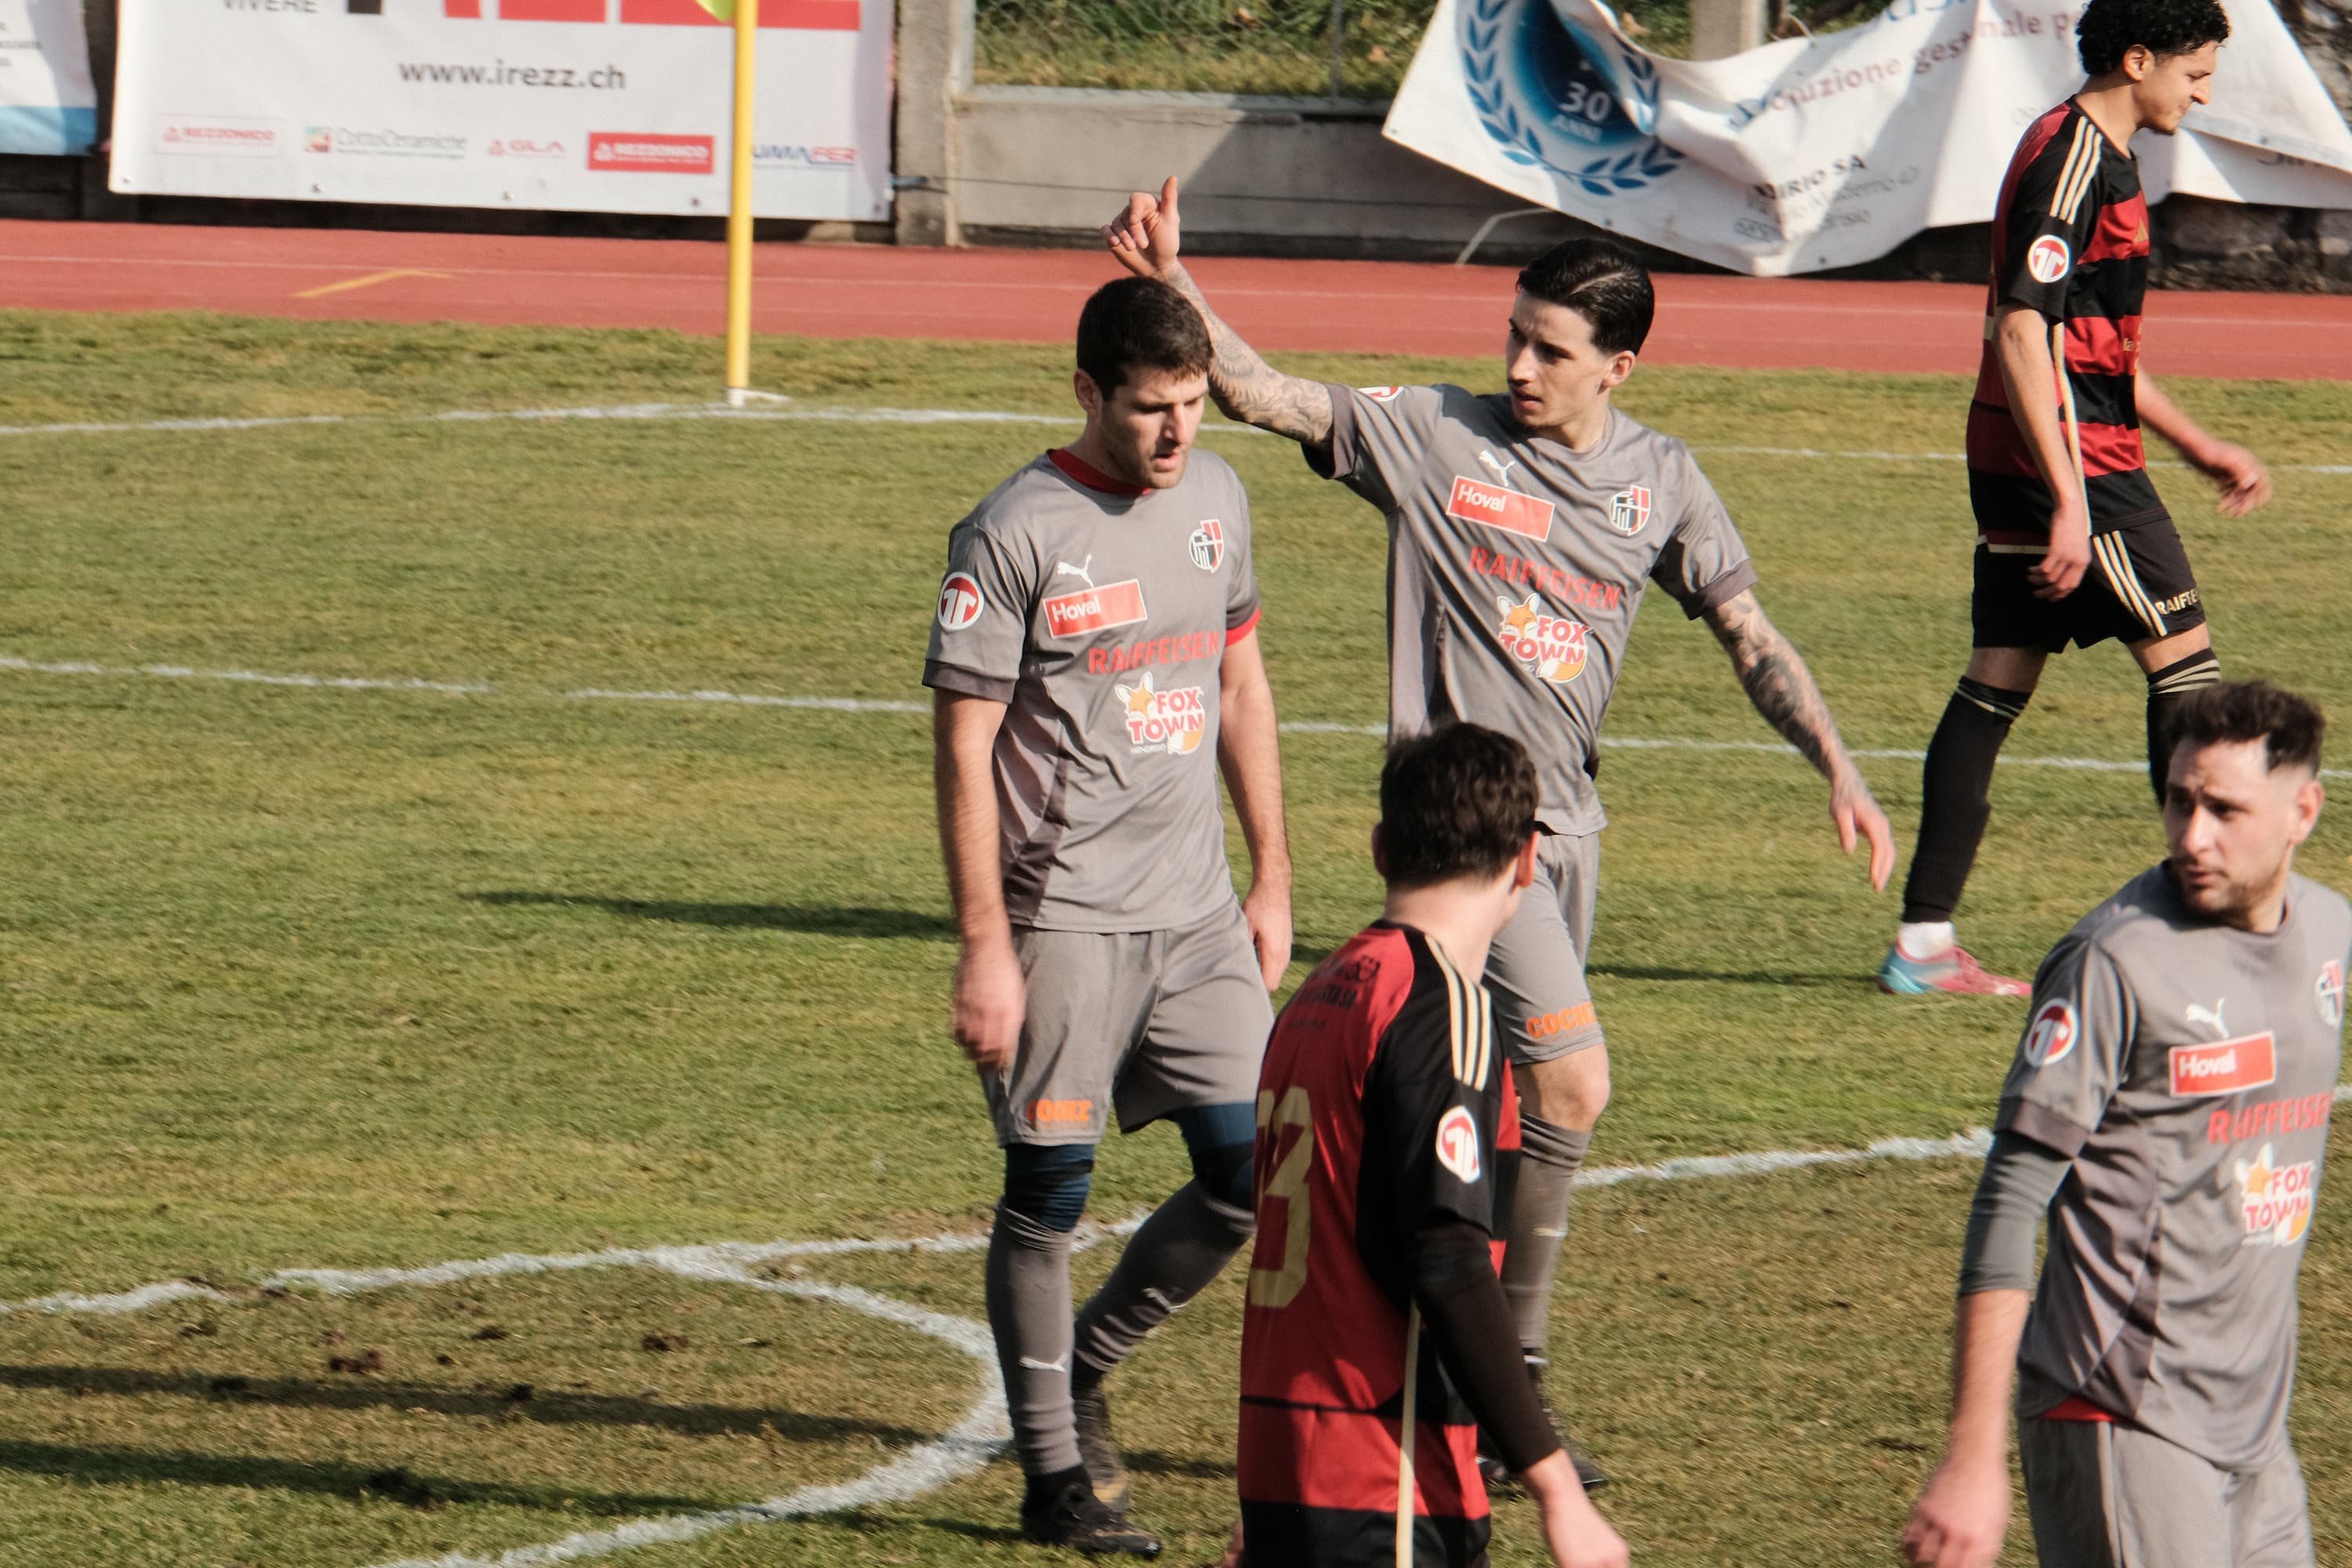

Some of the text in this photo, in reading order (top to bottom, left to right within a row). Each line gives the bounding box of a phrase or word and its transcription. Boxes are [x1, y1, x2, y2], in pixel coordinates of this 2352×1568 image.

[397, 58, 626, 90] www.irezz.ch
[1558, 81, 1611, 122] 30
[1456, 482, 1508, 513] Hoval
[1468, 546, 1621, 612] RAIFFEISEN
[1051, 595, 1102, 622] Hoval
[1537, 615, 1590, 646] FOX
[1087, 629, 1220, 675] RAIFFEISEN
[1500, 633, 1586, 663] TOWN
[1156, 688, 1203, 715] FOX
[1127, 713, 1203, 742] TOWN
[2178, 1047, 2238, 1079] Hoval
[2270, 1166, 2311, 1196] FOX
[2245, 1196, 2310, 1230] TOWN
